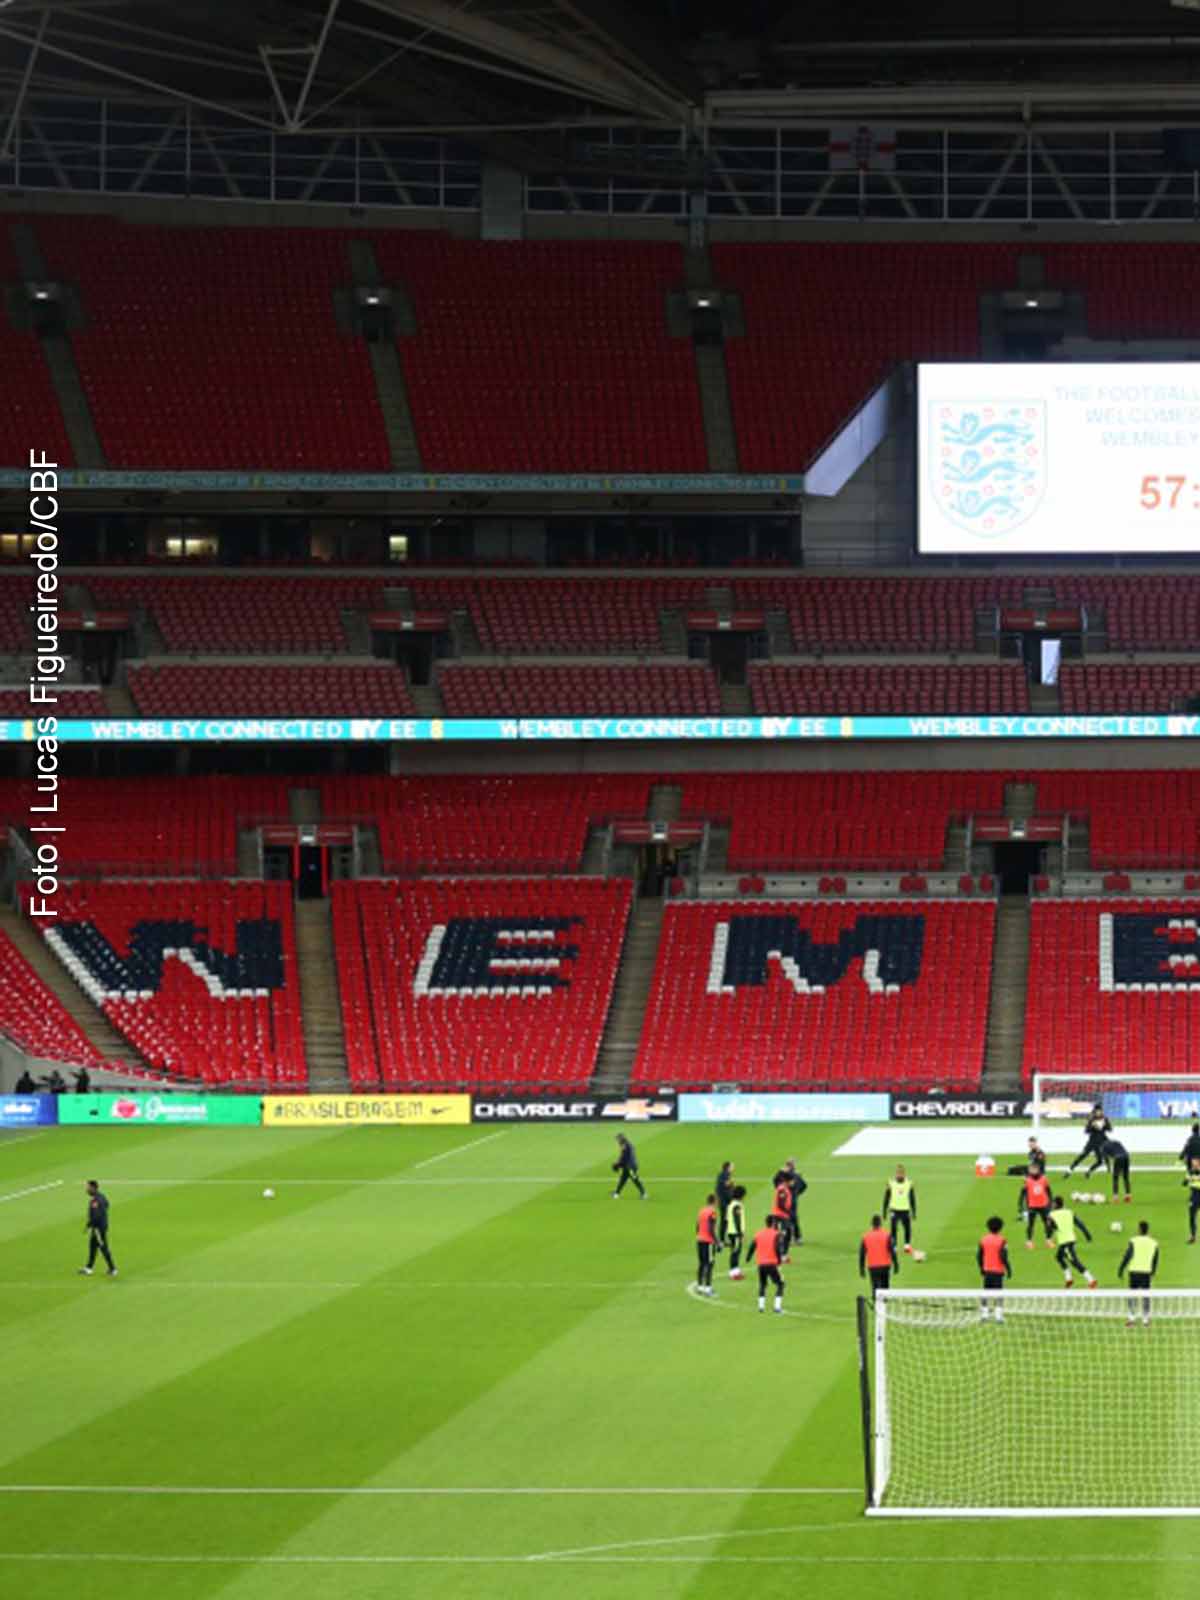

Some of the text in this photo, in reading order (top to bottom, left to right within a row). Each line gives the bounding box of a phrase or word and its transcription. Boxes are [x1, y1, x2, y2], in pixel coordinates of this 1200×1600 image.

[1086, 407, 1200, 423] WELCOMES
[1102, 431, 1200, 446] WEMBLEY
[92, 720, 199, 739] WEMBLEY
[205, 720, 341, 739] CONNECTED
[389, 720, 416, 739] EE
[500, 719, 610, 738] WEMBLEY
[616, 718, 751, 738] CONNECTED
[799, 717, 826, 737] EE
[909, 717, 1022, 736] WEMBLEY
[1023, 716, 1157, 736] CONNECTED
[474, 1102, 596, 1118] CHEVROLET
[894, 1101, 1017, 1117] CHEVROLET
